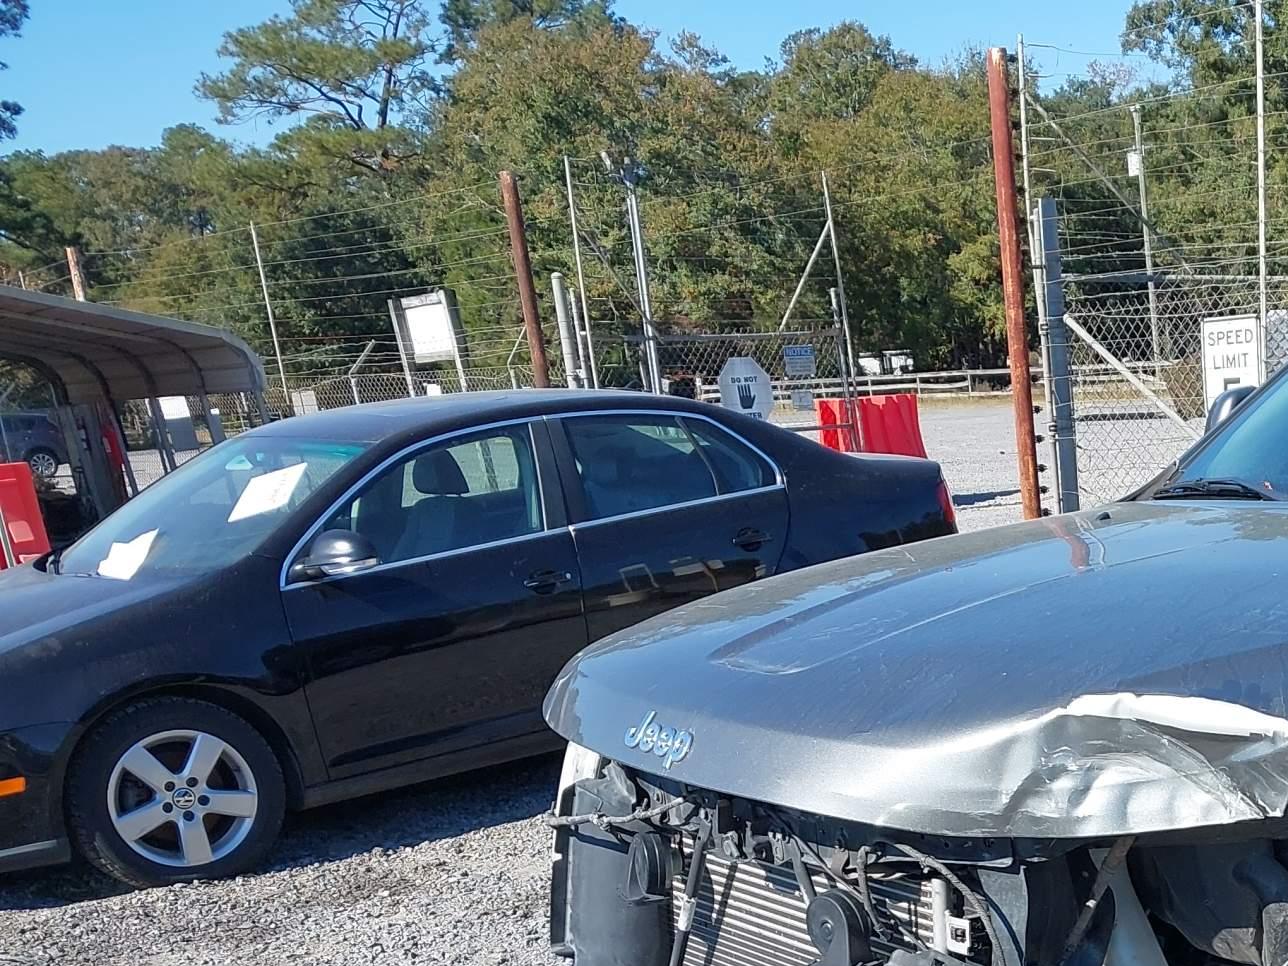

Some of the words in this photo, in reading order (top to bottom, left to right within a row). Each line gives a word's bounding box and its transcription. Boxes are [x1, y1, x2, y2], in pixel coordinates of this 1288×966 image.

[1207, 328, 1254, 347] SPEED
[785, 347, 813, 356] NOTICE
[1213, 352, 1249, 370] LIMIT
[730, 376, 741, 384] DO
[743, 375, 758, 383] NOT
[624, 710, 694, 770] Jeep
